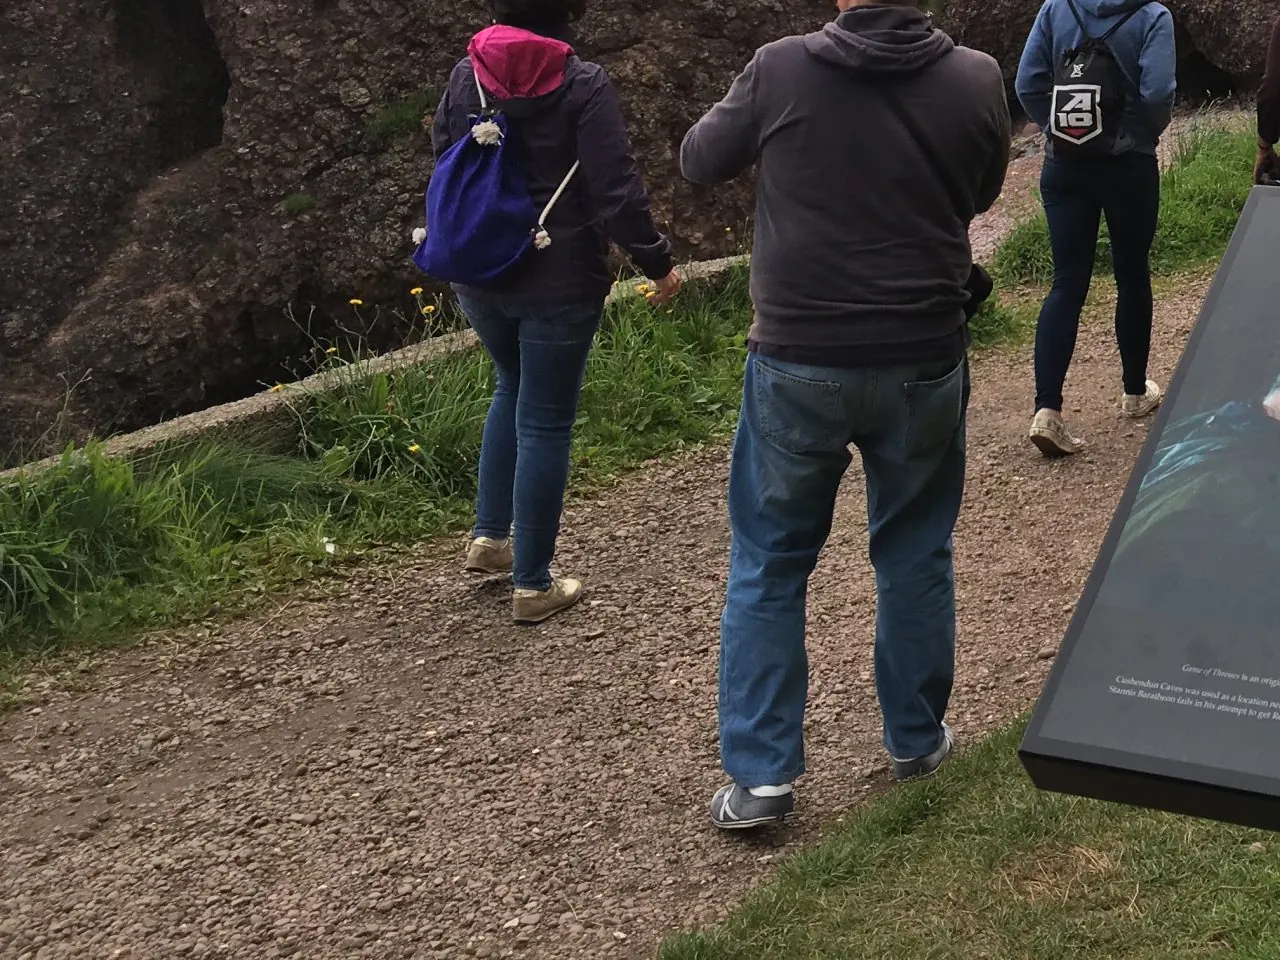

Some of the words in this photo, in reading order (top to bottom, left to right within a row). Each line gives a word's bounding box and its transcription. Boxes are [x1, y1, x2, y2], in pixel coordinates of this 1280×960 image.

[1061, 93, 1092, 111] A
[1056, 112, 1093, 127] 10
[1203, 668, 1213, 677] of
[1241, 673, 1248, 681] is
[1116, 676, 1159, 688] Cushendun
[1160, 682, 1183, 693] Caves
[1185, 688, 1200, 696] was
[1201, 691, 1221, 699] used
[1237, 695, 1268, 707] location
[1109, 685, 1136, 696] Stannis
[1176, 696, 1193, 705] fails
[1194, 699, 1203, 707] in
[1203, 700, 1216, 709] his
[1216, 704, 1247, 716] attempt
[1248, 708, 1257, 716] to
[1257, 711, 1271, 719] get
